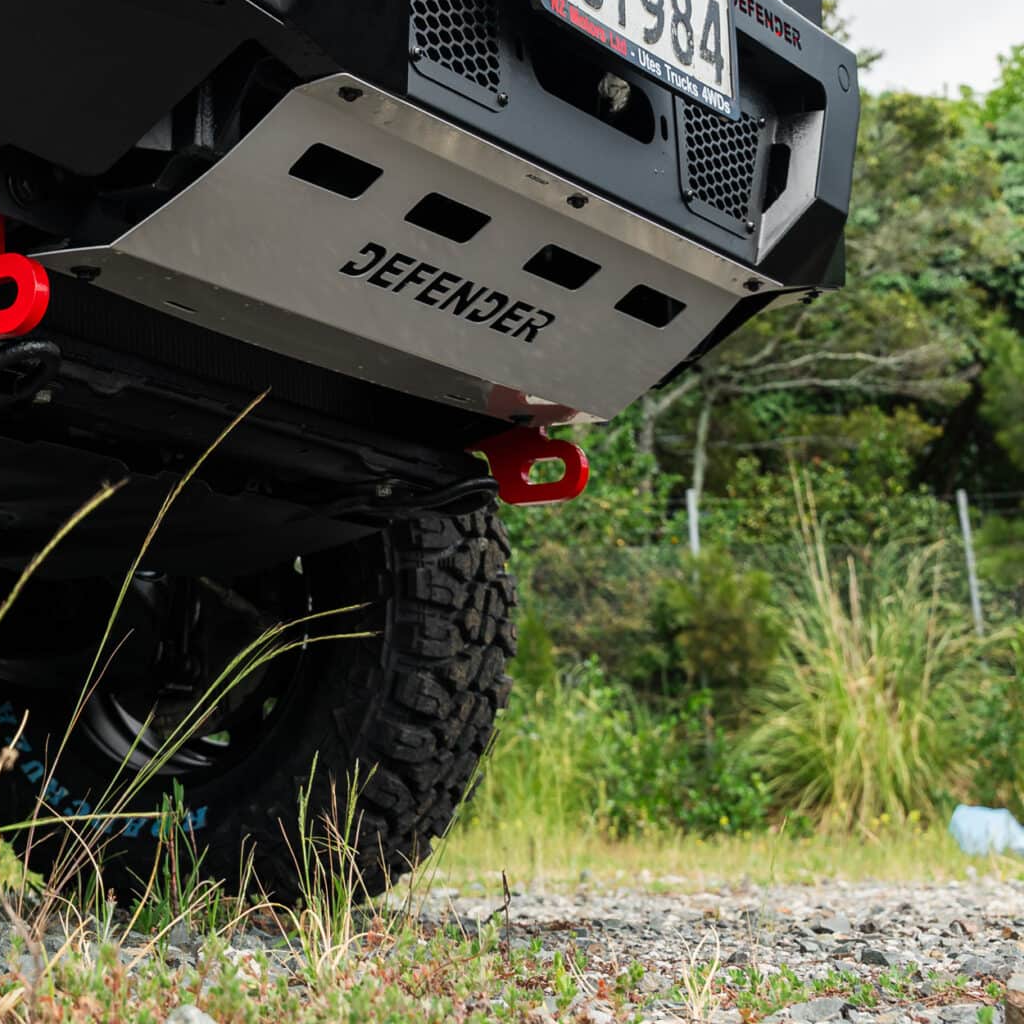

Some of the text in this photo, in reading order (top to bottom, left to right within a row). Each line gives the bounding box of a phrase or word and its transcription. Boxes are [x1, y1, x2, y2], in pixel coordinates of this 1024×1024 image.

[569, 4, 607, 43] Motors
[609, 32, 627, 56] Ltd
[638, 48, 662, 76] Utes
[664, 64, 699, 97] Trucks
[702, 86, 731, 114] 4WDs
[339, 242, 556, 343] DEFENDER
